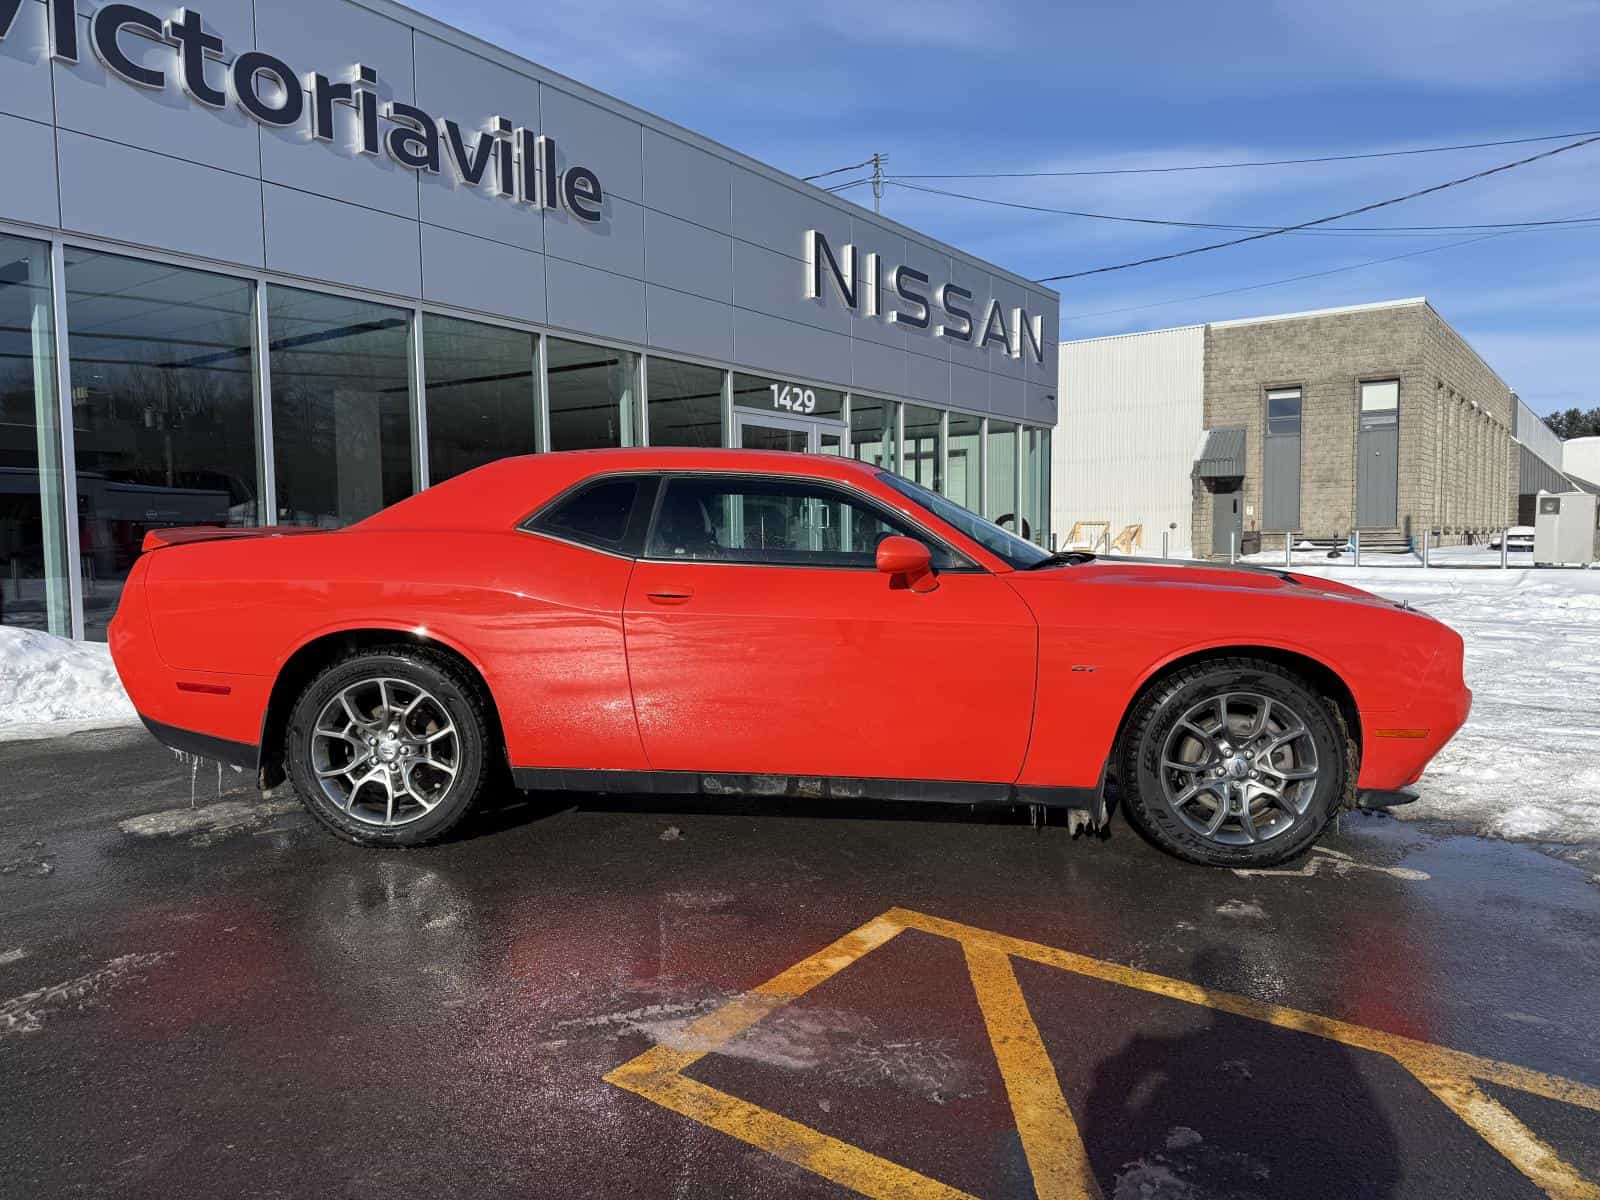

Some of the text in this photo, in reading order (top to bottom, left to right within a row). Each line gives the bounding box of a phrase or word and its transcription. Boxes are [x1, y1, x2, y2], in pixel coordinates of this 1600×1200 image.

[0, 0, 603, 222] ictoriaville
[805, 229, 1043, 363] NISSAN
[770, 383, 816, 413] 1429
